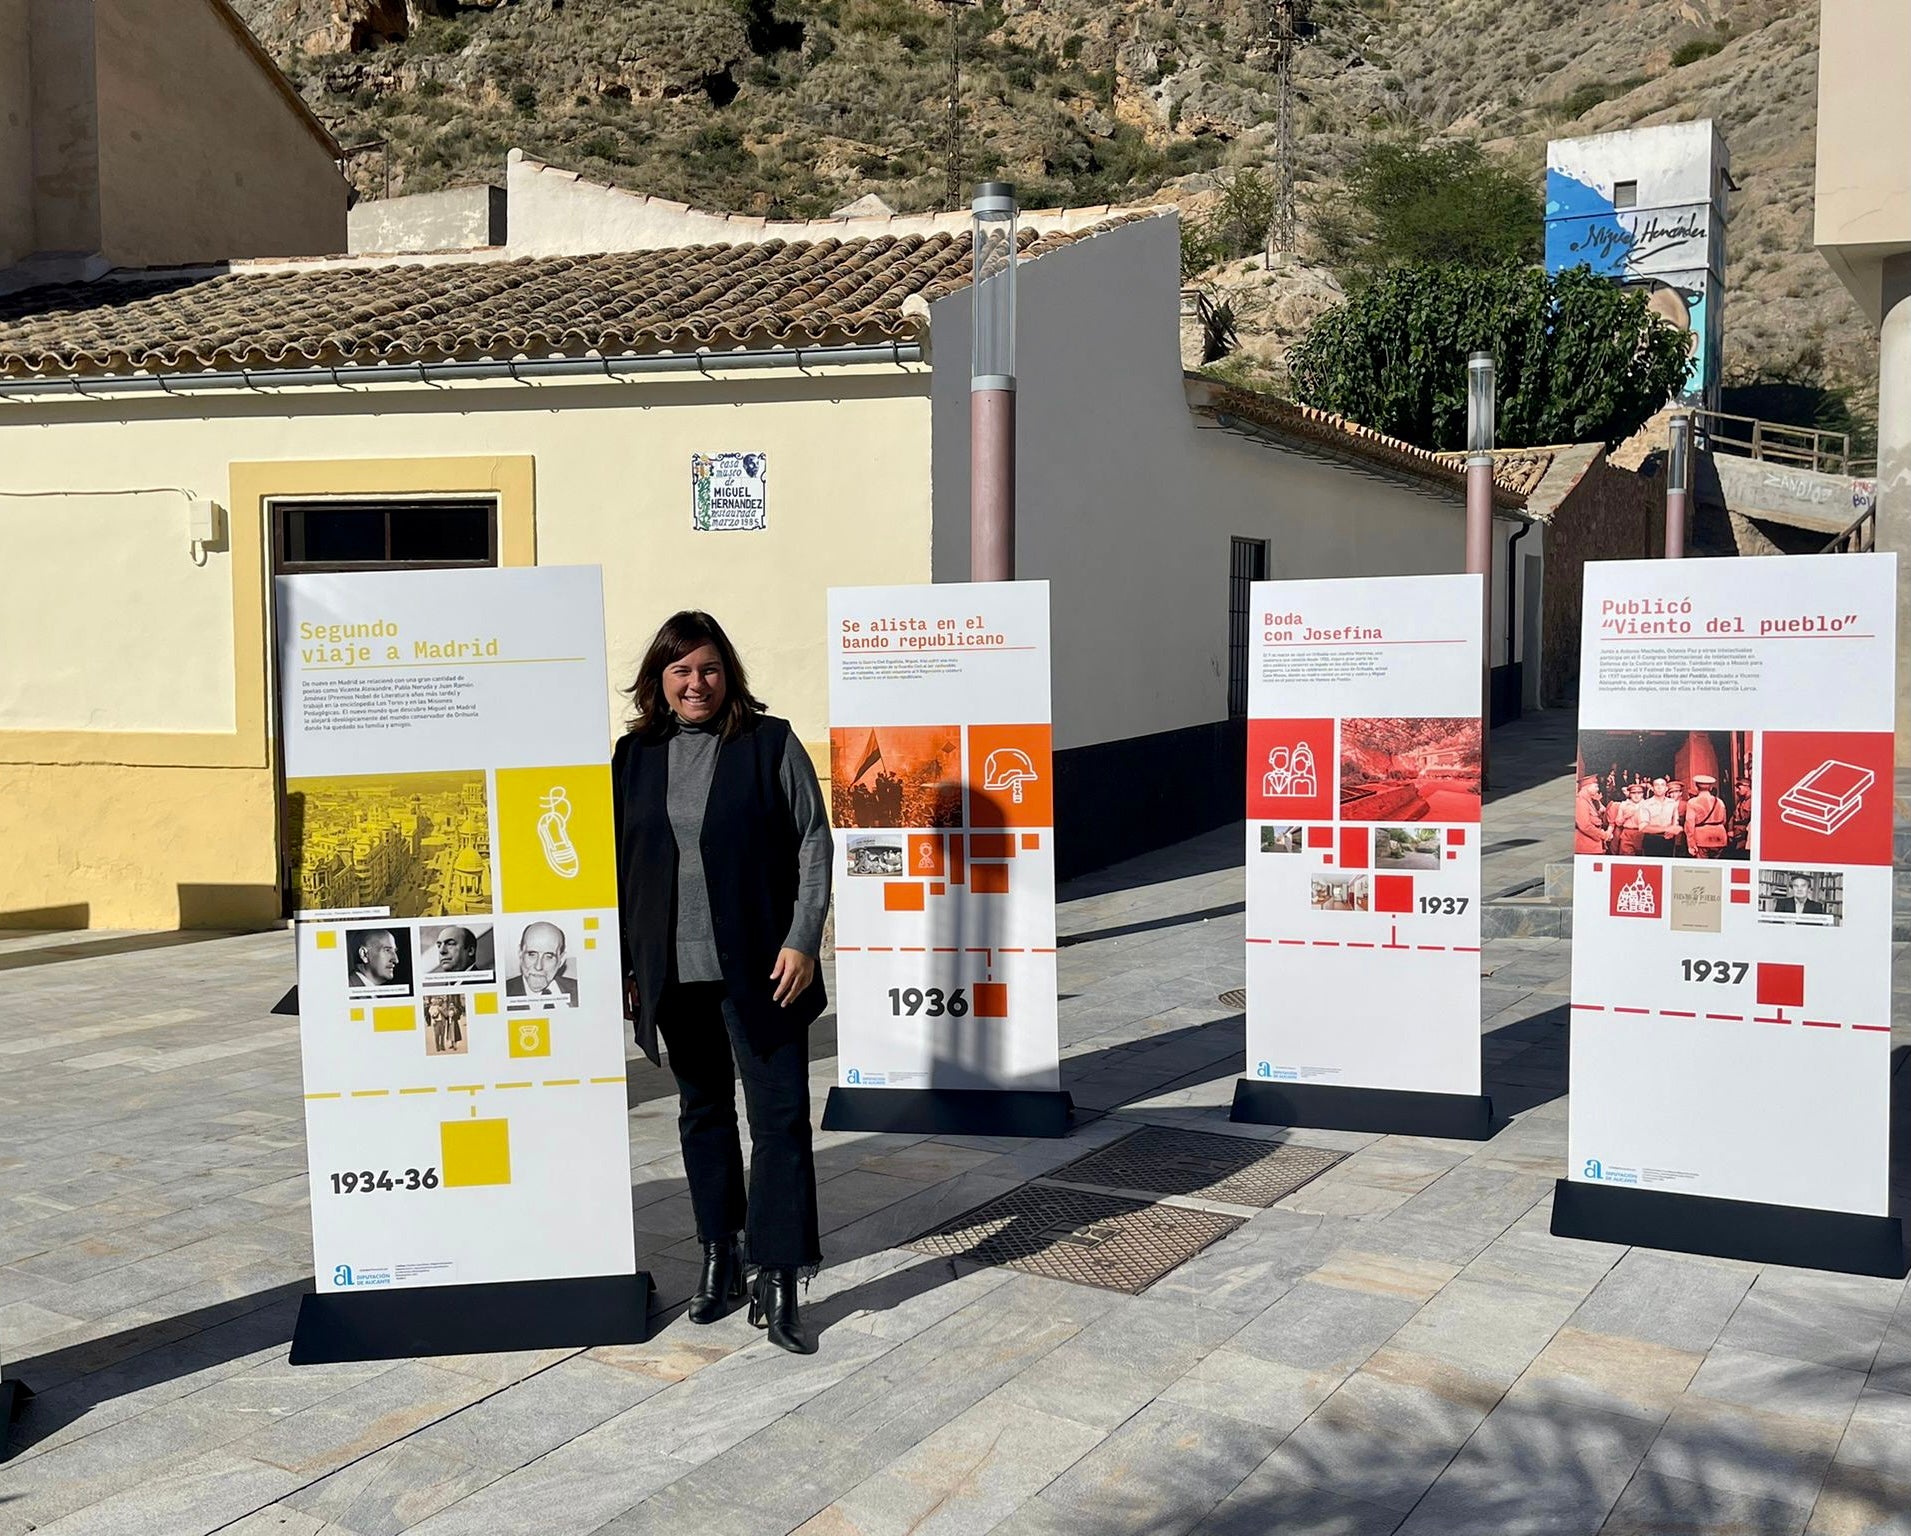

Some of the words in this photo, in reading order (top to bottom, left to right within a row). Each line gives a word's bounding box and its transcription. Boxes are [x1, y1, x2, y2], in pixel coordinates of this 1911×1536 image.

[720, 460, 740, 469] casa
[716, 469, 742, 477] museo
[724, 477, 735, 486] de
[714, 487, 751, 497] MIGUEL
[711, 499, 763, 509] HERNANDEZ
[711, 518, 740, 527] marzo
[741, 518, 760, 526] 1985
[1602, 597, 1692, 616] Publicó
[842, 619, 860, 633] Se
[870, 618, 928, 632] alista
[937, 619, 956, 630] en
[966, 616, 985, 629] el
[1263, 612, 1303, 626] Boda
[1602, 618, 1692, 635] “Viento
[1706, 617, 1744, 633] del
[1759, 615, 1858, 635] pueblo”
[299, 619, 399, 643] Segundo
[1264, 630, 1293, 642] con
[1303, 626, 1383, 641] Josefina
[842, 635, 889, 649] bando
[899, 633, 1005, 649] republicano
[302, 643, 371, 666] viaje
[386, 645, 400, 661] a
[414, 639, 499, 659] Madrid
[1419, 896, 1470, 916] 1937
[1681, 958, 1750, 985] 1937
[888, 987, 969, 1018] 1936
[330, 1167, 439, 1195] 1934-36
